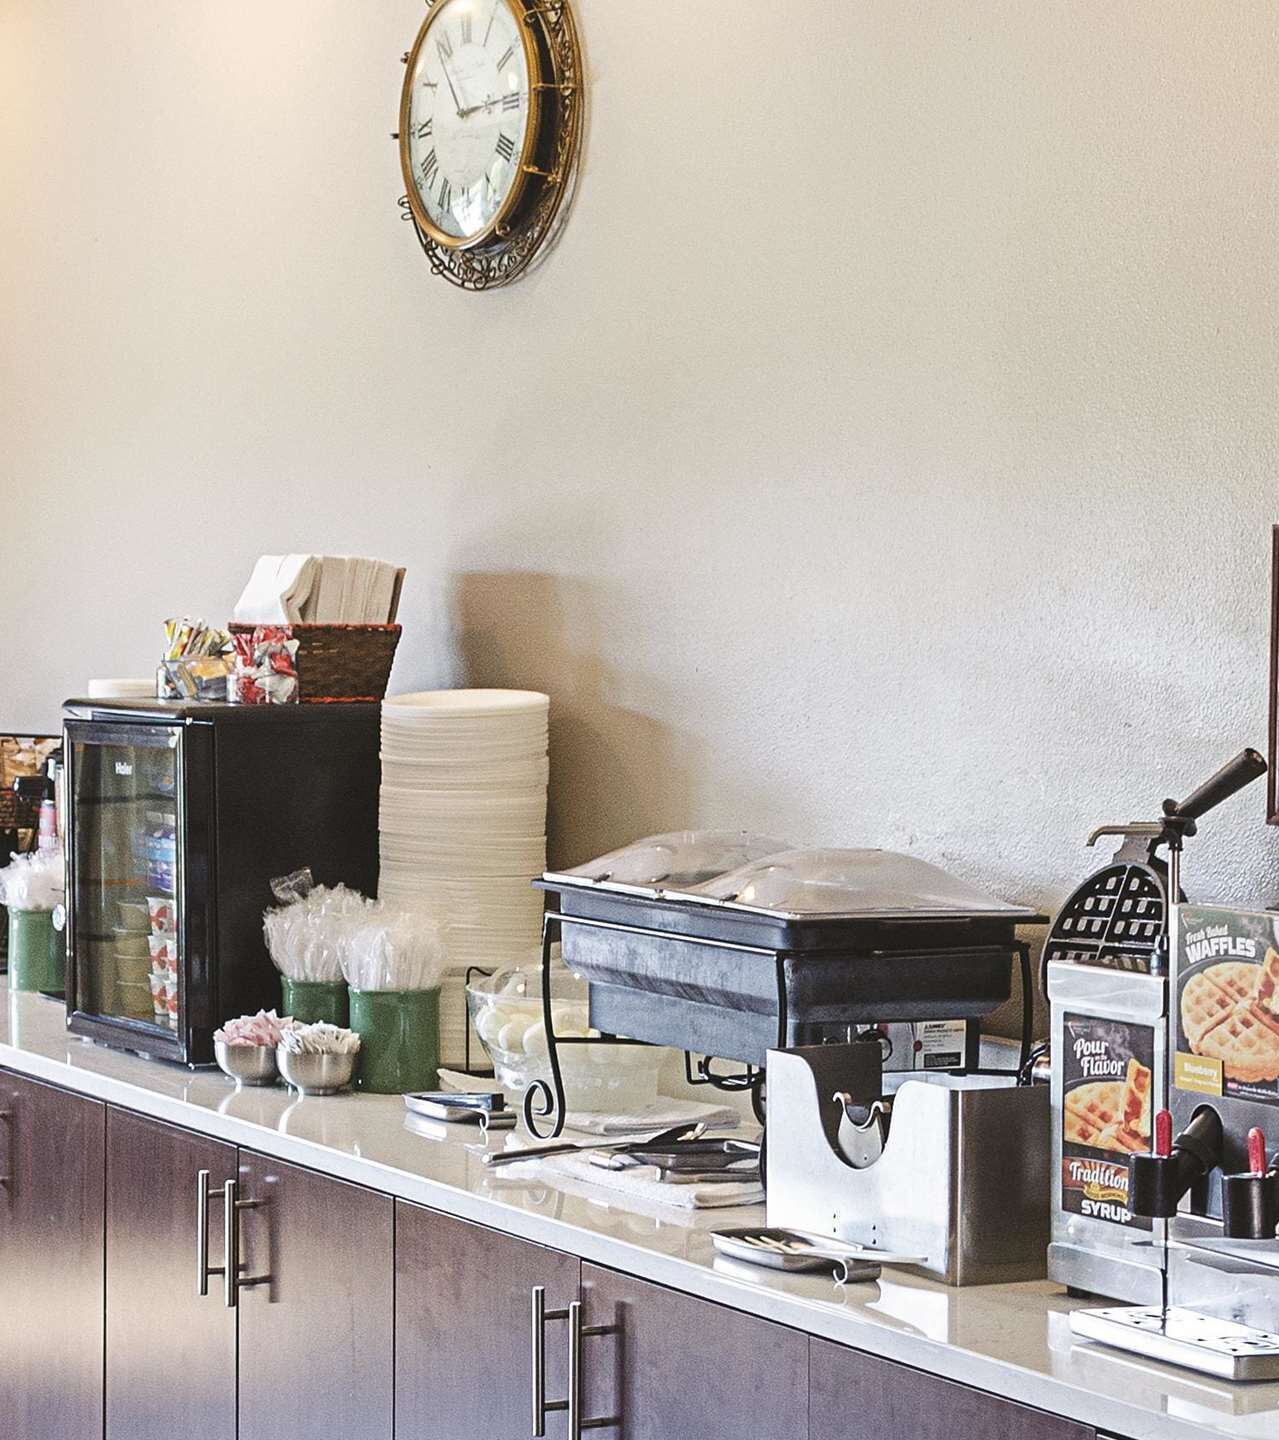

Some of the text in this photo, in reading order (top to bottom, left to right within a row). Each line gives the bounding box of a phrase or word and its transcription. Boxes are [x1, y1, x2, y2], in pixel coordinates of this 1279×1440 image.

[1185, 929, 1206, 945] Fresh
[1185, 936, 1256, 963] WAFFLES
[1073, 1038, 1109, 1059] Pour
[1080, 1056, 1125, 1077] Flavor
[1081, 1199, 1132, 1223] SYRUP
